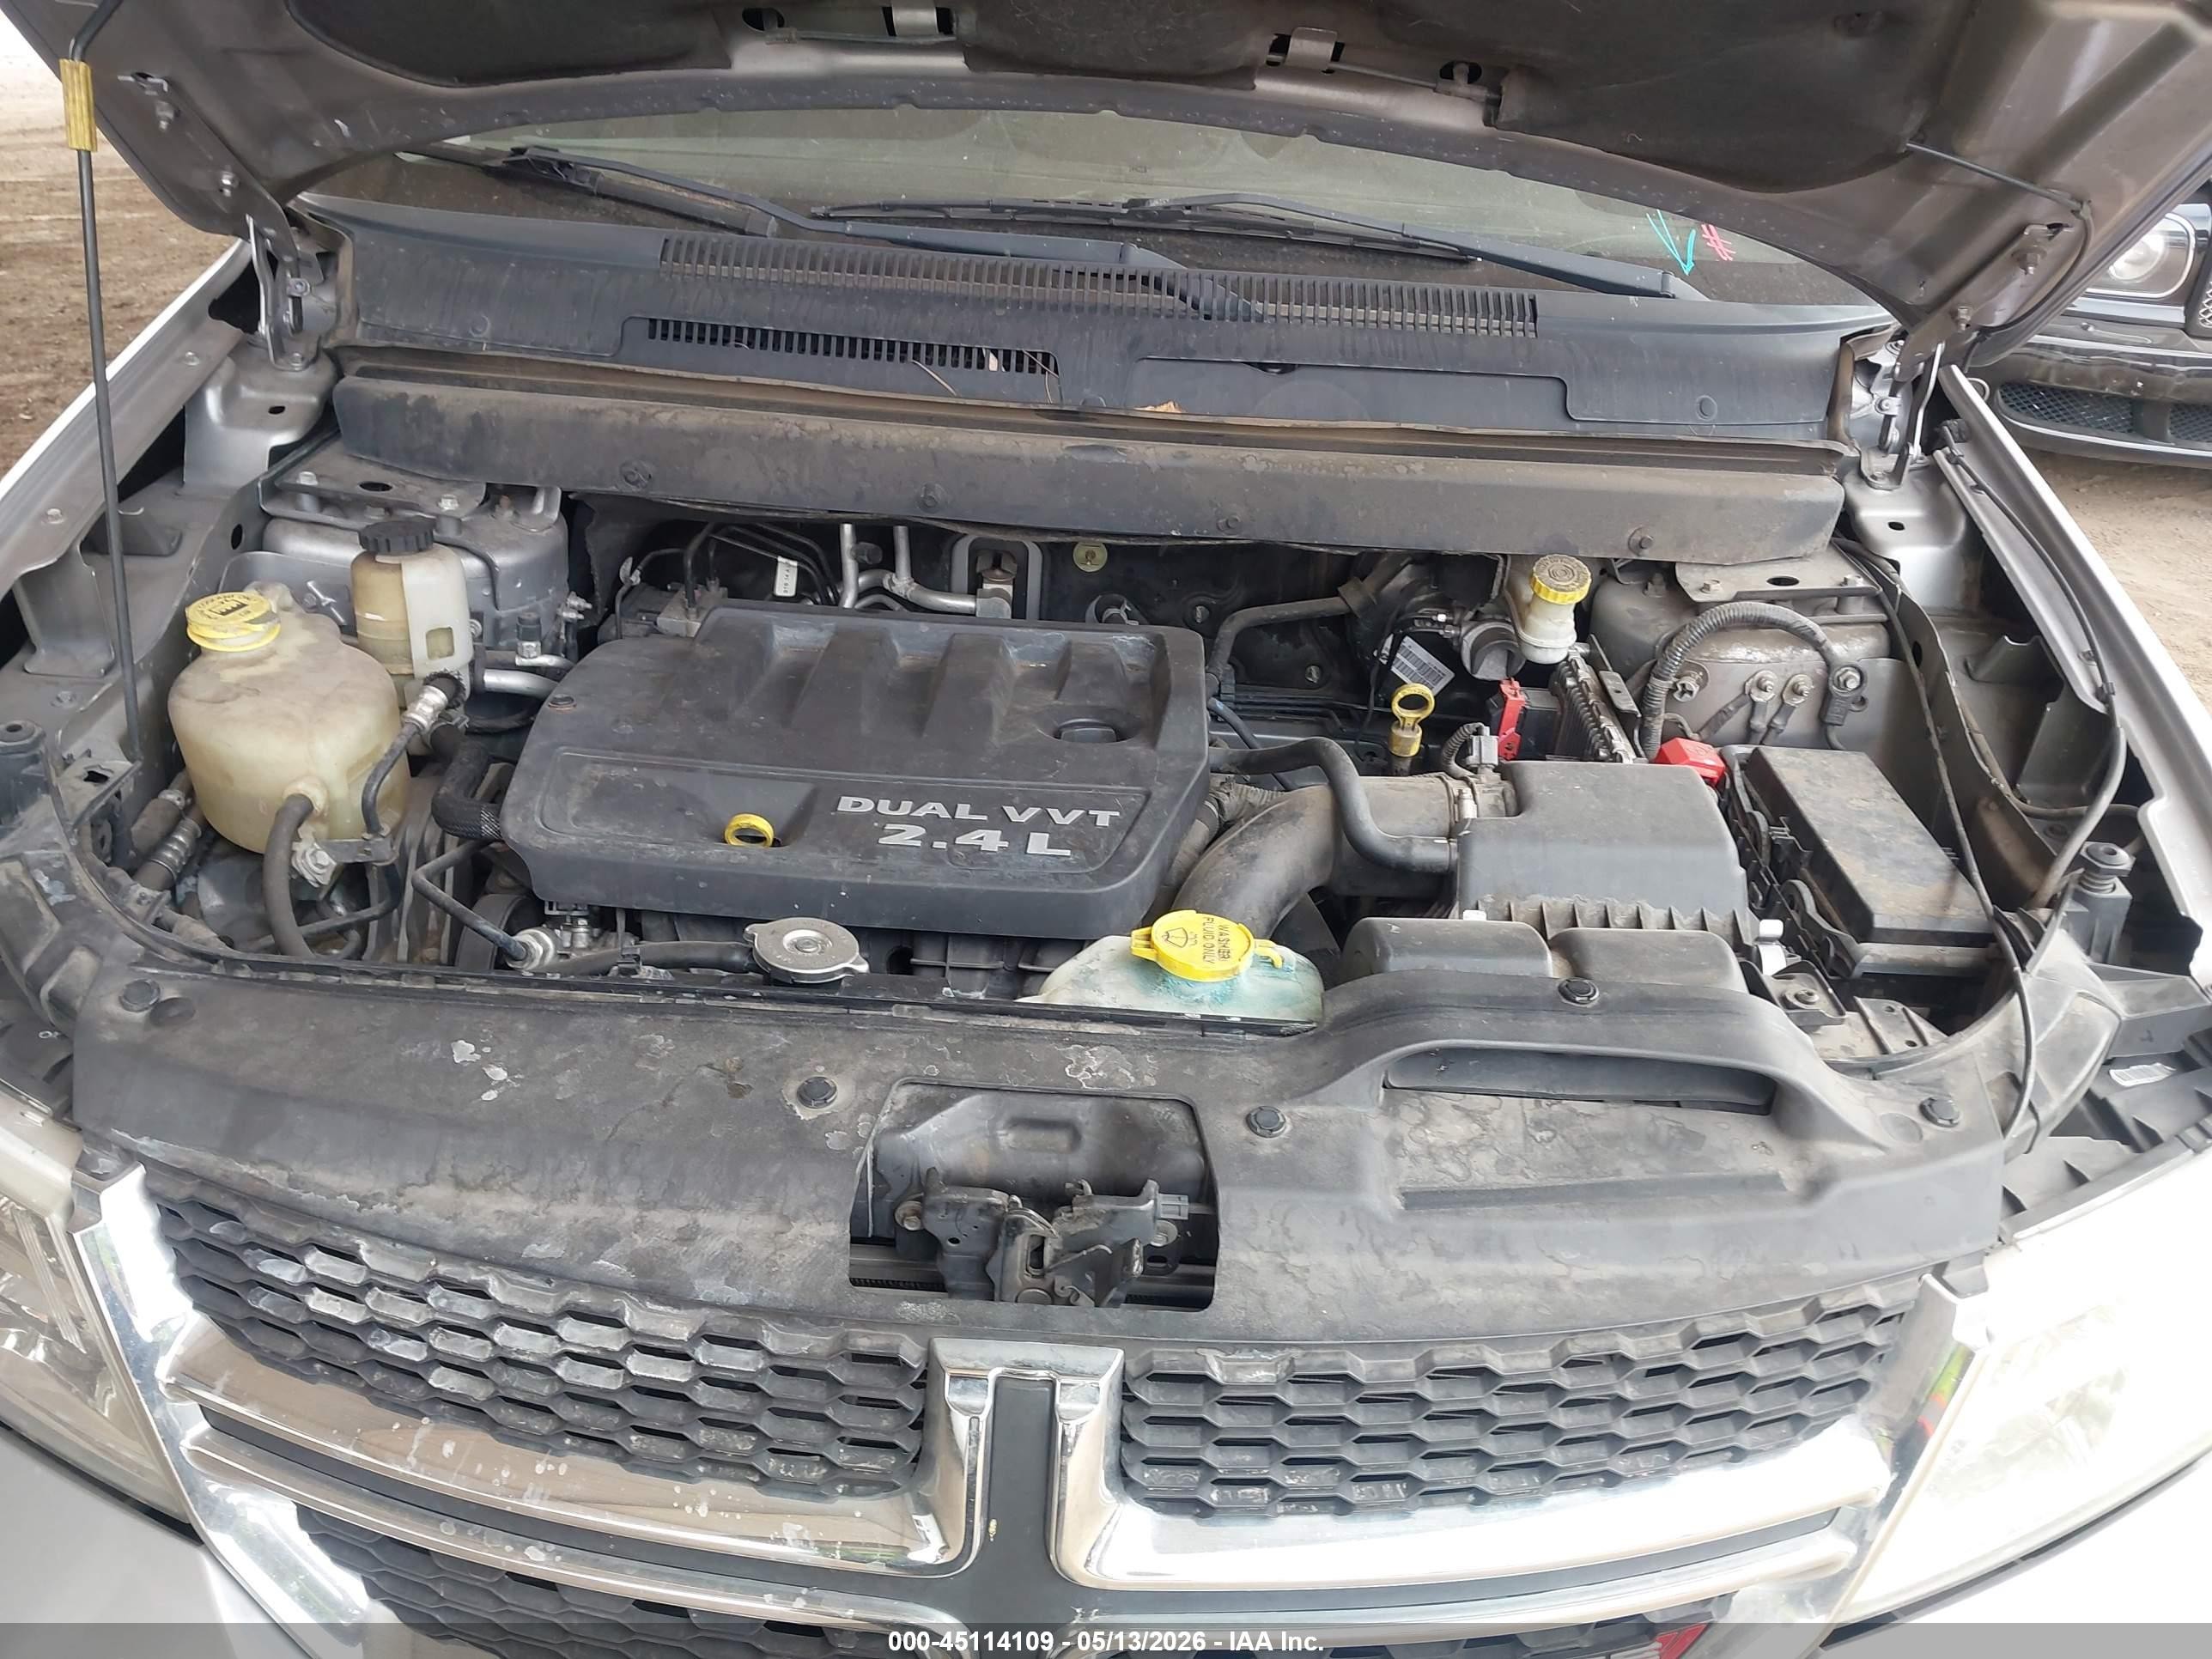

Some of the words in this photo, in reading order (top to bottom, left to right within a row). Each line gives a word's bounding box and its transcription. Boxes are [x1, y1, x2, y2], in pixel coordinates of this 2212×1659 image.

[836, 796, 988, 821] DUAL
[1002, 805, 1121, 827] VVT
[1202, 916, 1214, 941] FLUID
[1218, 924, 1231, 961] WASHER
[1202, 942, 1215, 964] ONLY
